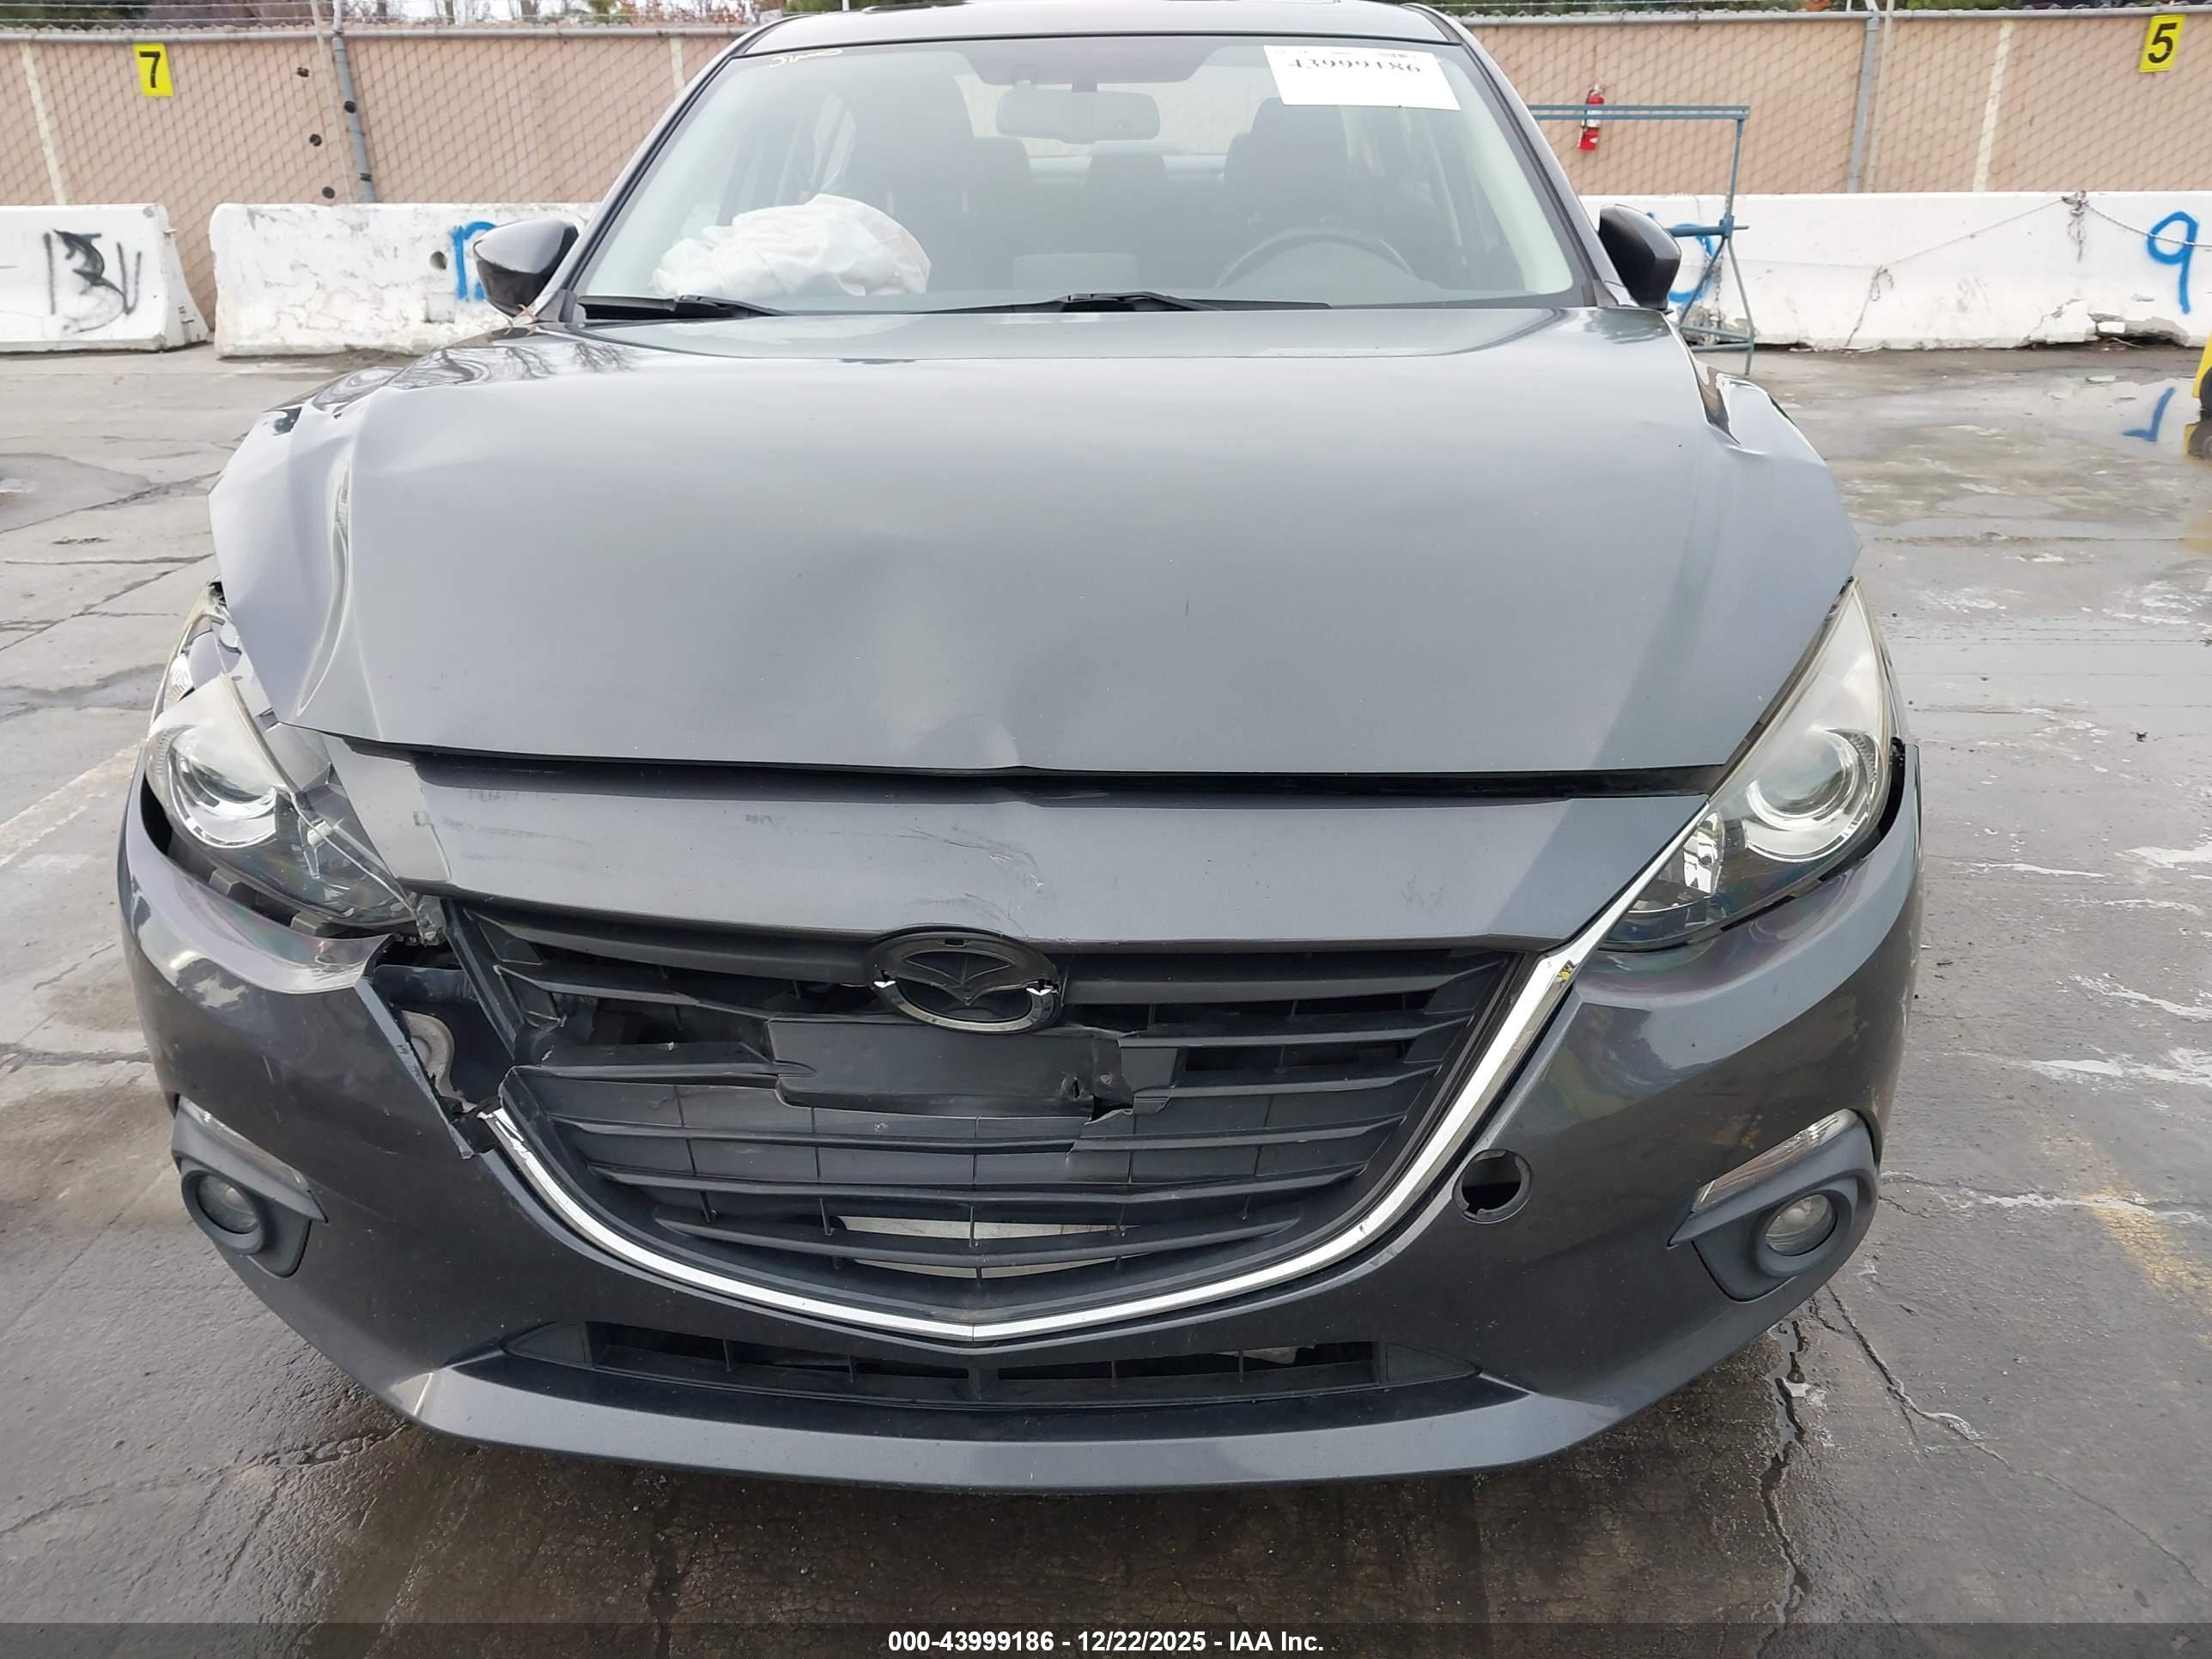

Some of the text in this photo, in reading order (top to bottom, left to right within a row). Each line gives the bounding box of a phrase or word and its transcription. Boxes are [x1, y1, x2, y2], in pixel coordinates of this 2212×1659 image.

[2148, 22, 2178, 64] 5
[138, 51, 161, 88] 7
[2147, 210, 2199, 315] 9
